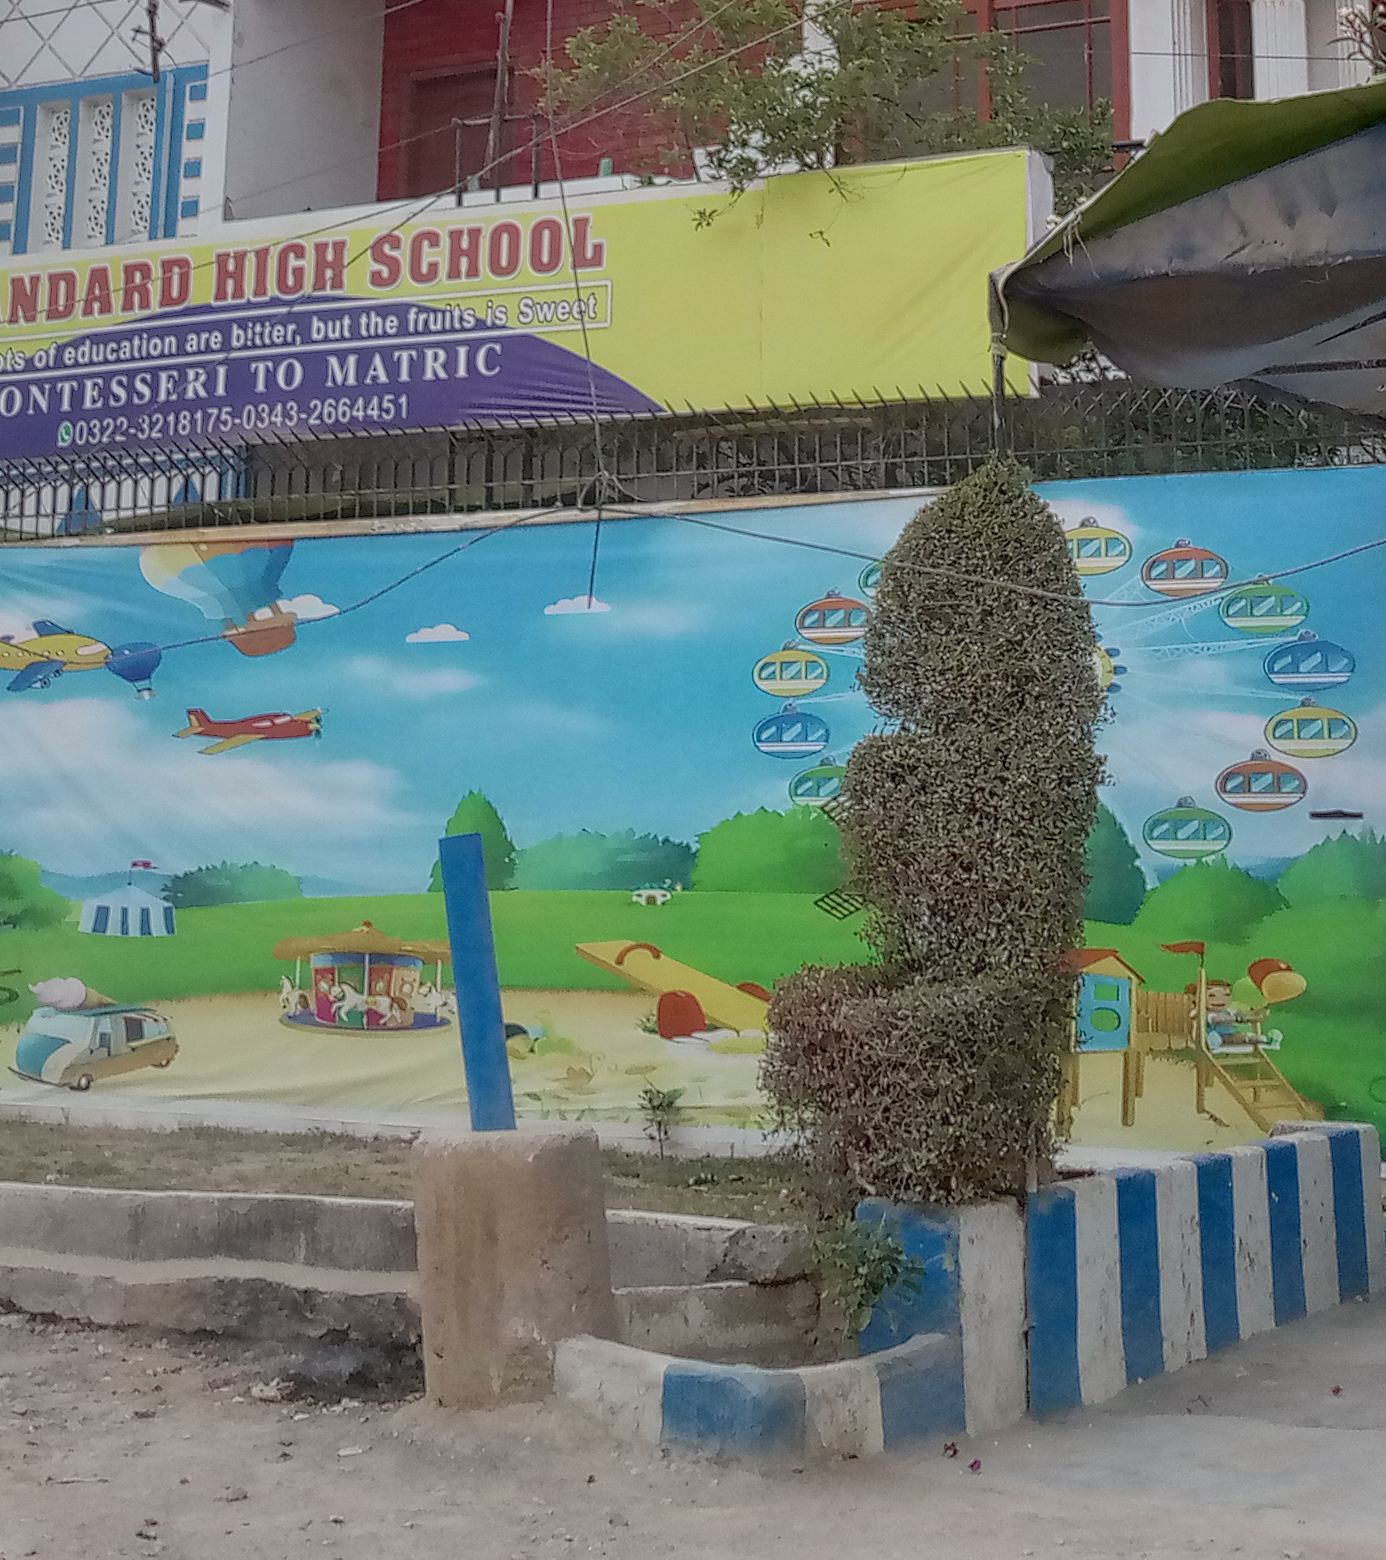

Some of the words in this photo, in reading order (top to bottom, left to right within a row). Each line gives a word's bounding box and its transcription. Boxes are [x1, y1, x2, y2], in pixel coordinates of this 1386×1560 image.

[213, 239, 348, 305] HIGH
[368, 214, 606, 290] SCHOOL
[33, 342, 59, 369] of
[63, 333, 178, 366] education
[186, 329, 223, 353] are
[230, 321, 303, 351] bitter,
[312, 315, 354, 342] but
[359, 310, 399, 337] the
[407, 304, 477, 334] fruits
[485, 301, 508, 328] is
[517, 294, 598, 325] Sweet
[251, 358, 305, 395] TO
[326, 342, 504, 389] MATRIC
[73, 393, 410, 447] 0322-3218175-0343-2664451
